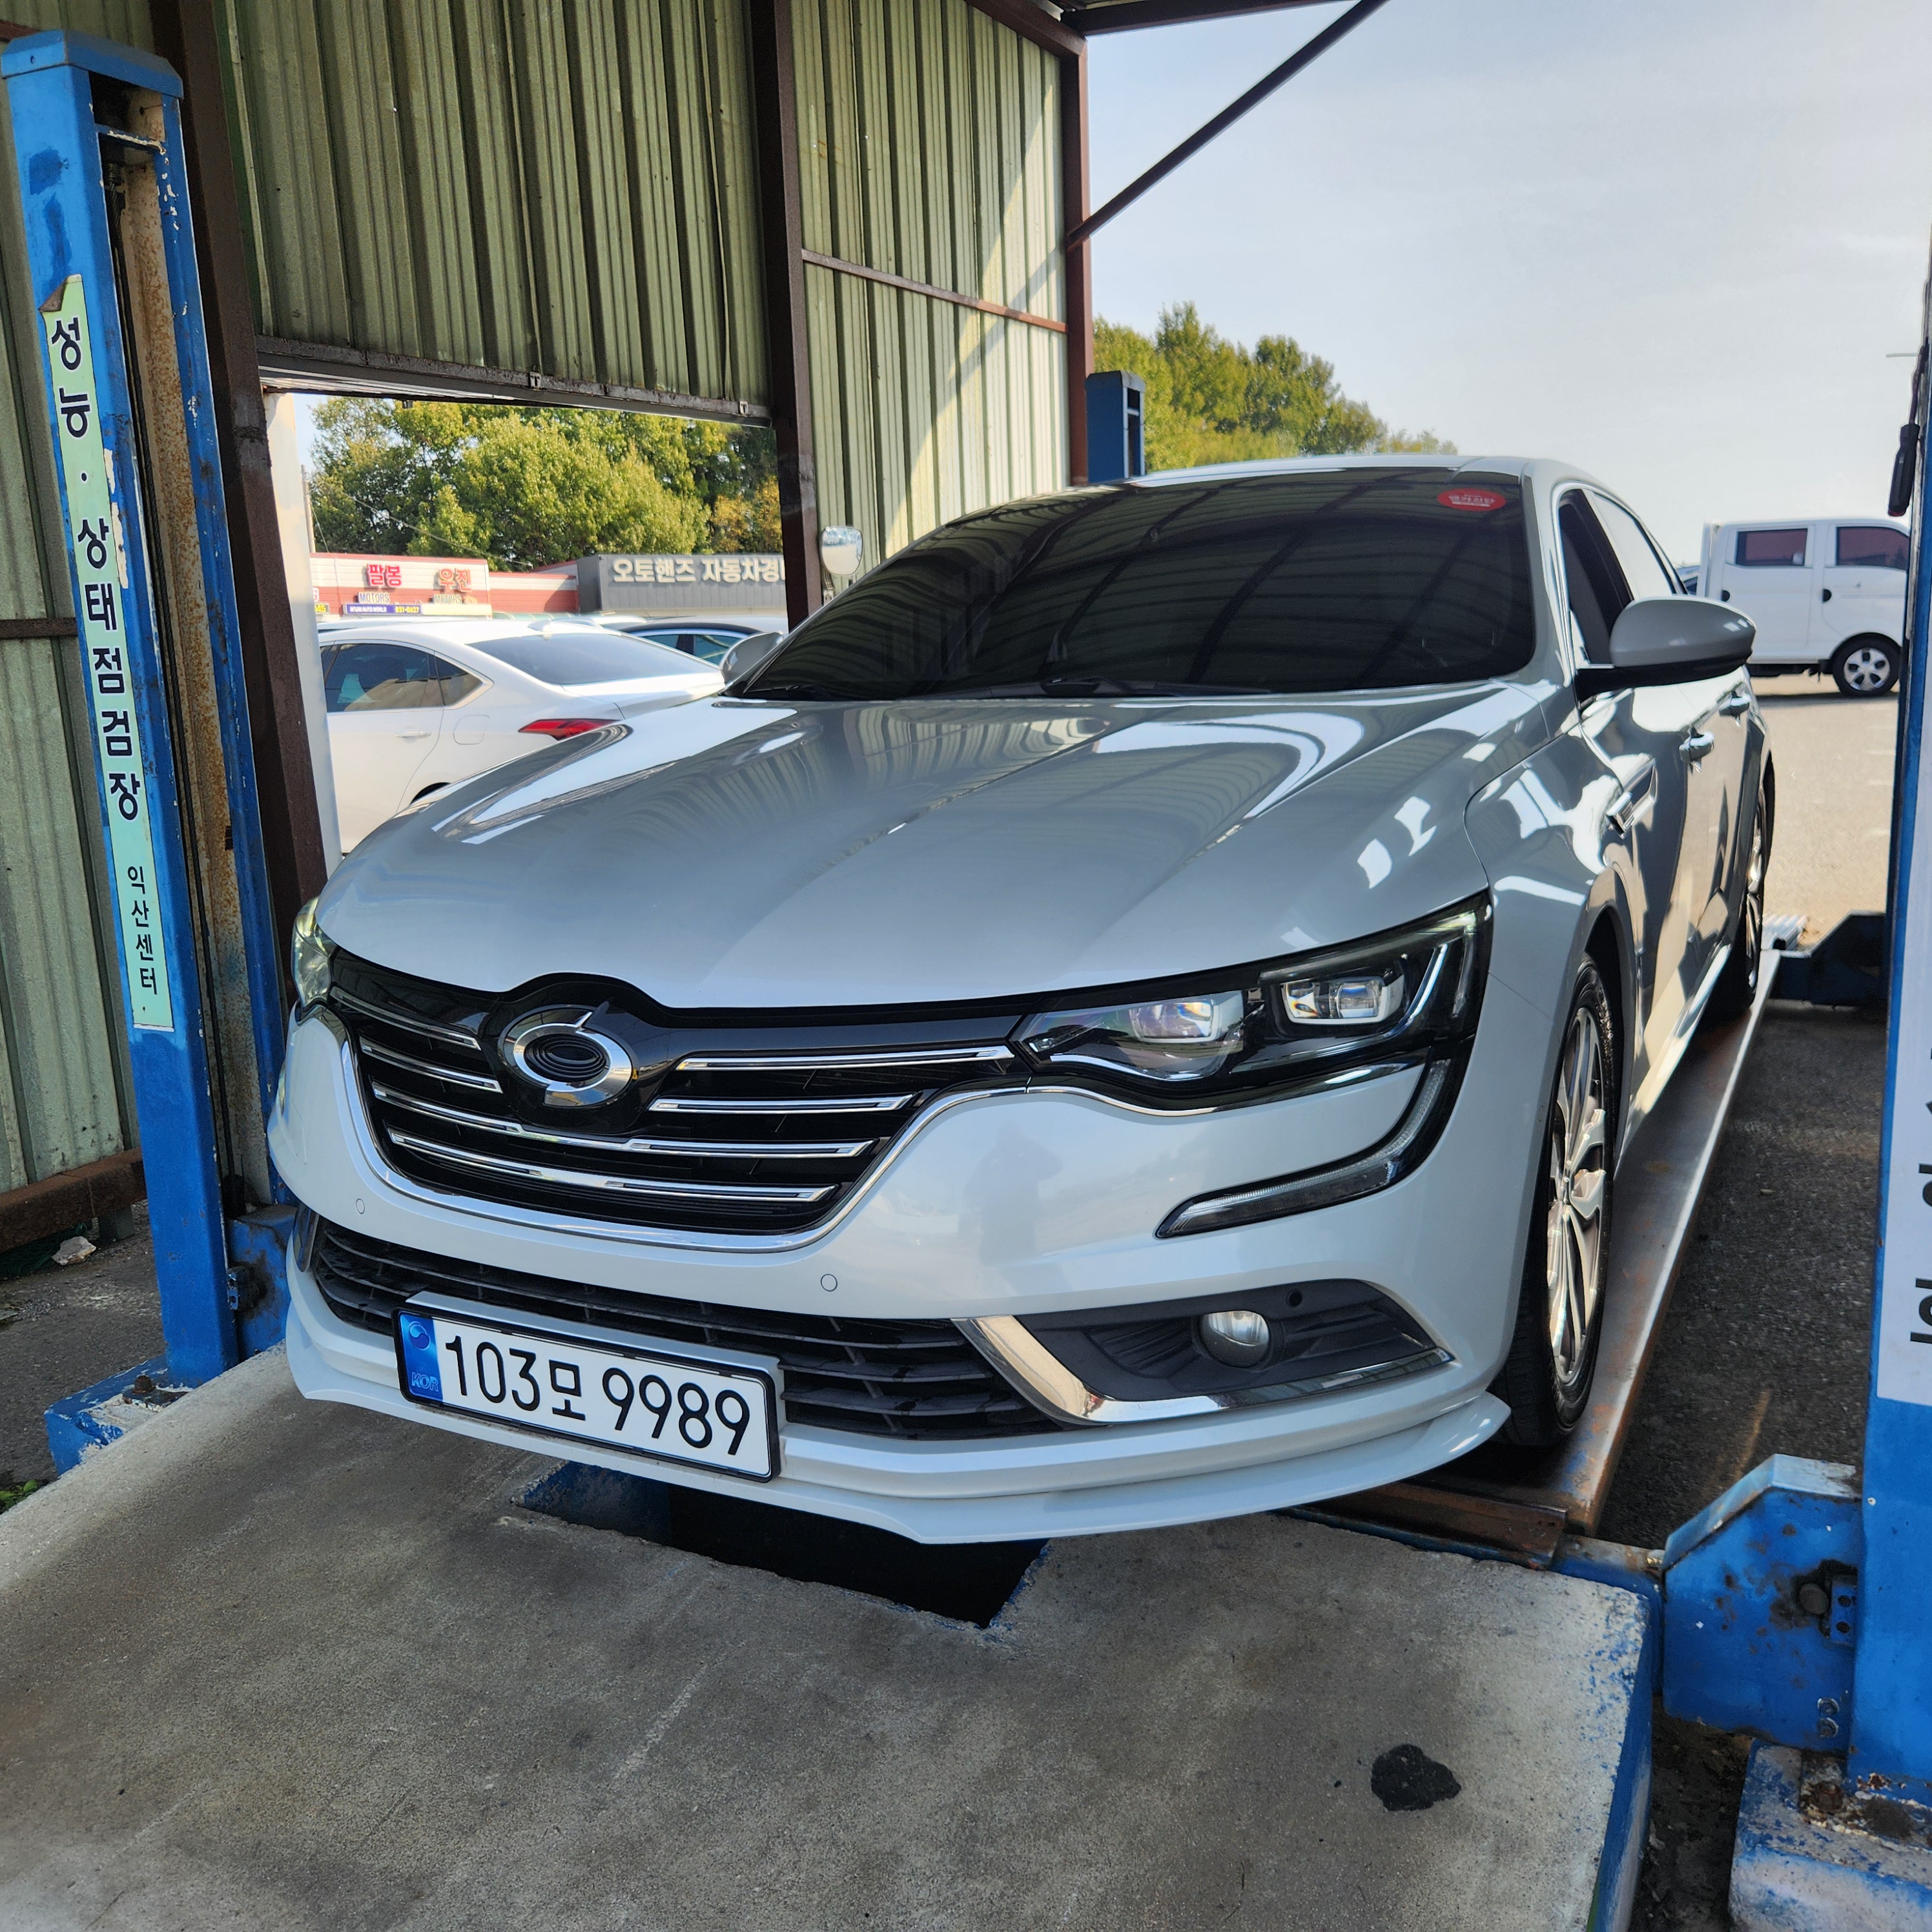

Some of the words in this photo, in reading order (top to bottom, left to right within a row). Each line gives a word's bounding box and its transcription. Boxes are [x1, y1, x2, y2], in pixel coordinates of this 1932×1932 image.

[367, 564, 402, 587] 팔봉
[439, 568, 472, 593] 우진
[613, 558, 696, 582] 오토핸즈
[359, 592, 390, 603] MOTORS
[127, 865, 157, 995] 익산센터
[411, 1372, 439, 1392] KOR
[445, 1335, 586, 1421] 103모
[602, 1367, 751, 1456] 9989
